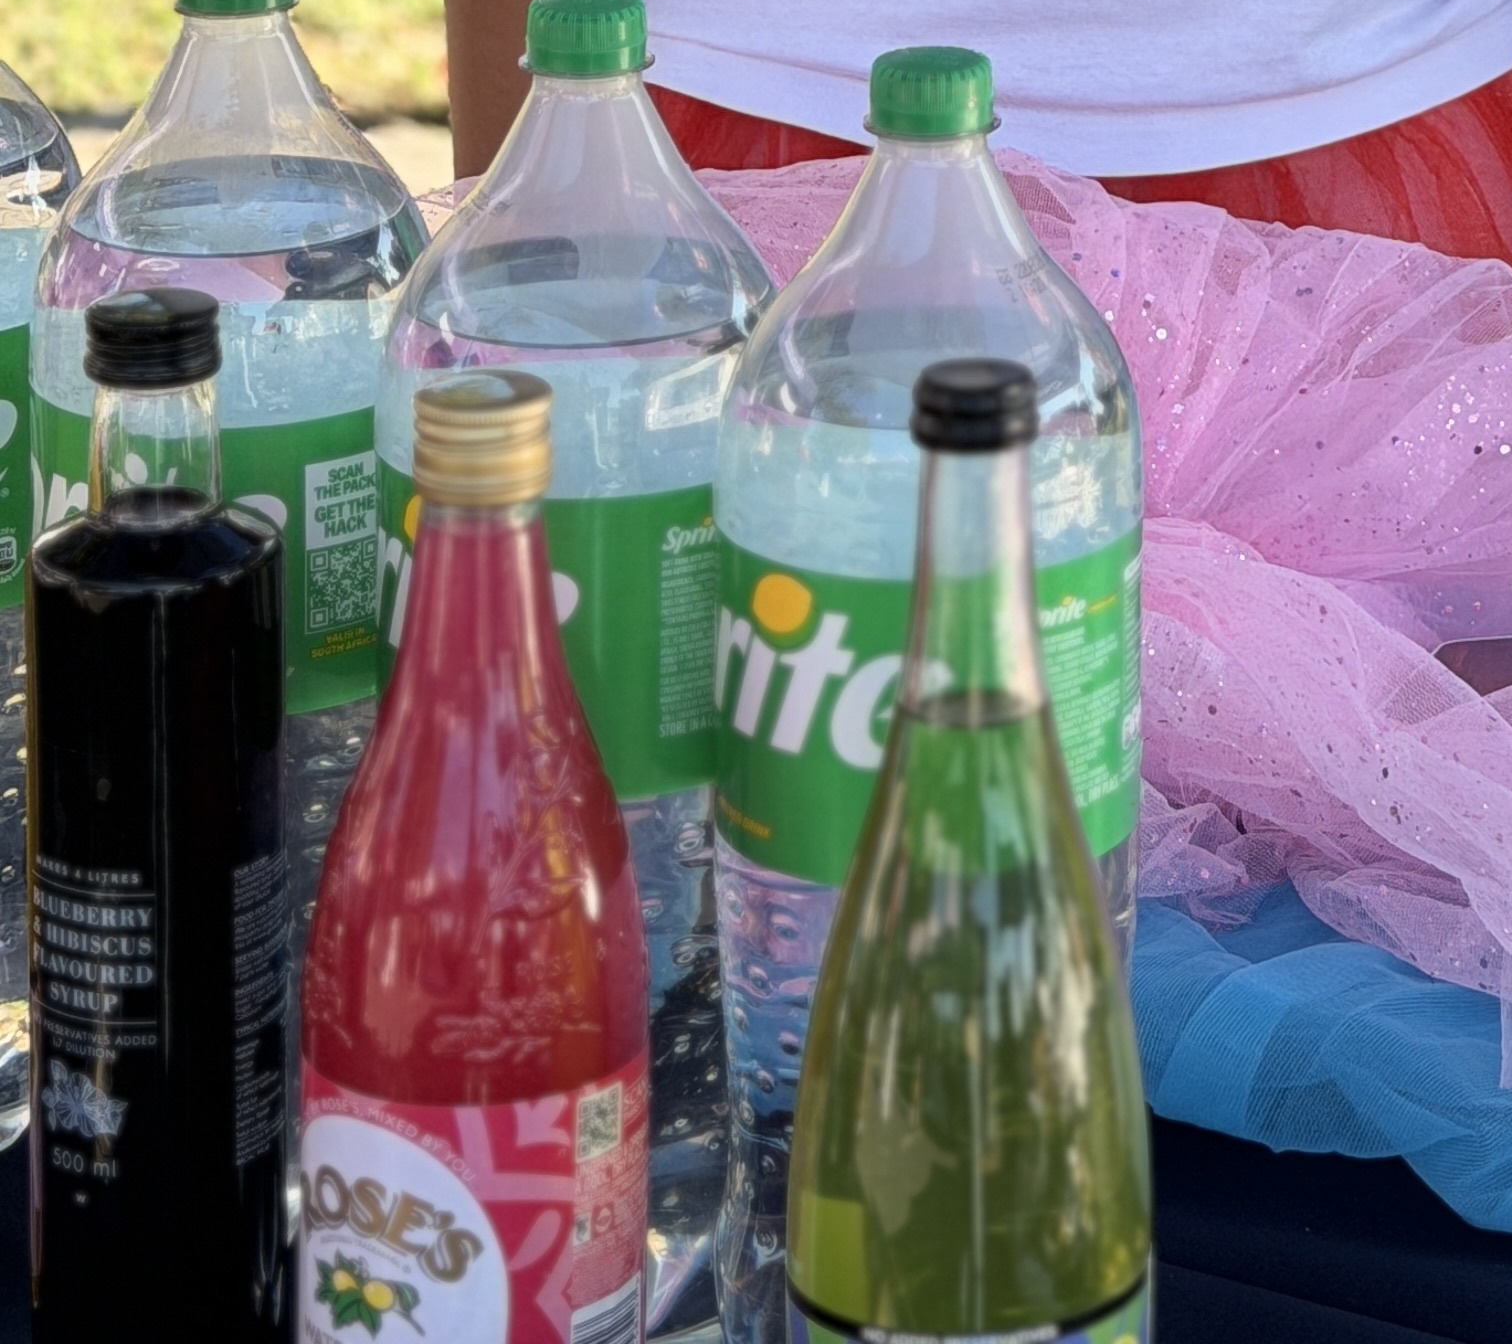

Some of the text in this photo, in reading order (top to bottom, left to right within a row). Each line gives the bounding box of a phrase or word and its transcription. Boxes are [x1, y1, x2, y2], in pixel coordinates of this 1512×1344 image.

[314, 472, 377, 501] THE PACK
[327, 461, 364, 484] SCAN
[314, 492, 376, 524] GET THE
[323, 512, 368, 539] HACK
[661, 516, 716, 555] Sprit
[87, 871, 140, 885] LITRES
[32, 884, 153, 928] BLUEBERRY
[46, 922, 152, 957] HIBISCUS
[32, 940, 154, 984] FLAVOURED
[49, 980, 119, 1013] SYRUP
[65, 1041, 116, 1060] DILUTION
[114, 1034, 157, 1047] ADDED
[366, 1105, 419, 1139] MIXED
[420, 1133, 443, 1153] BY
[52, 1146, 117, 1178] 500 ml
